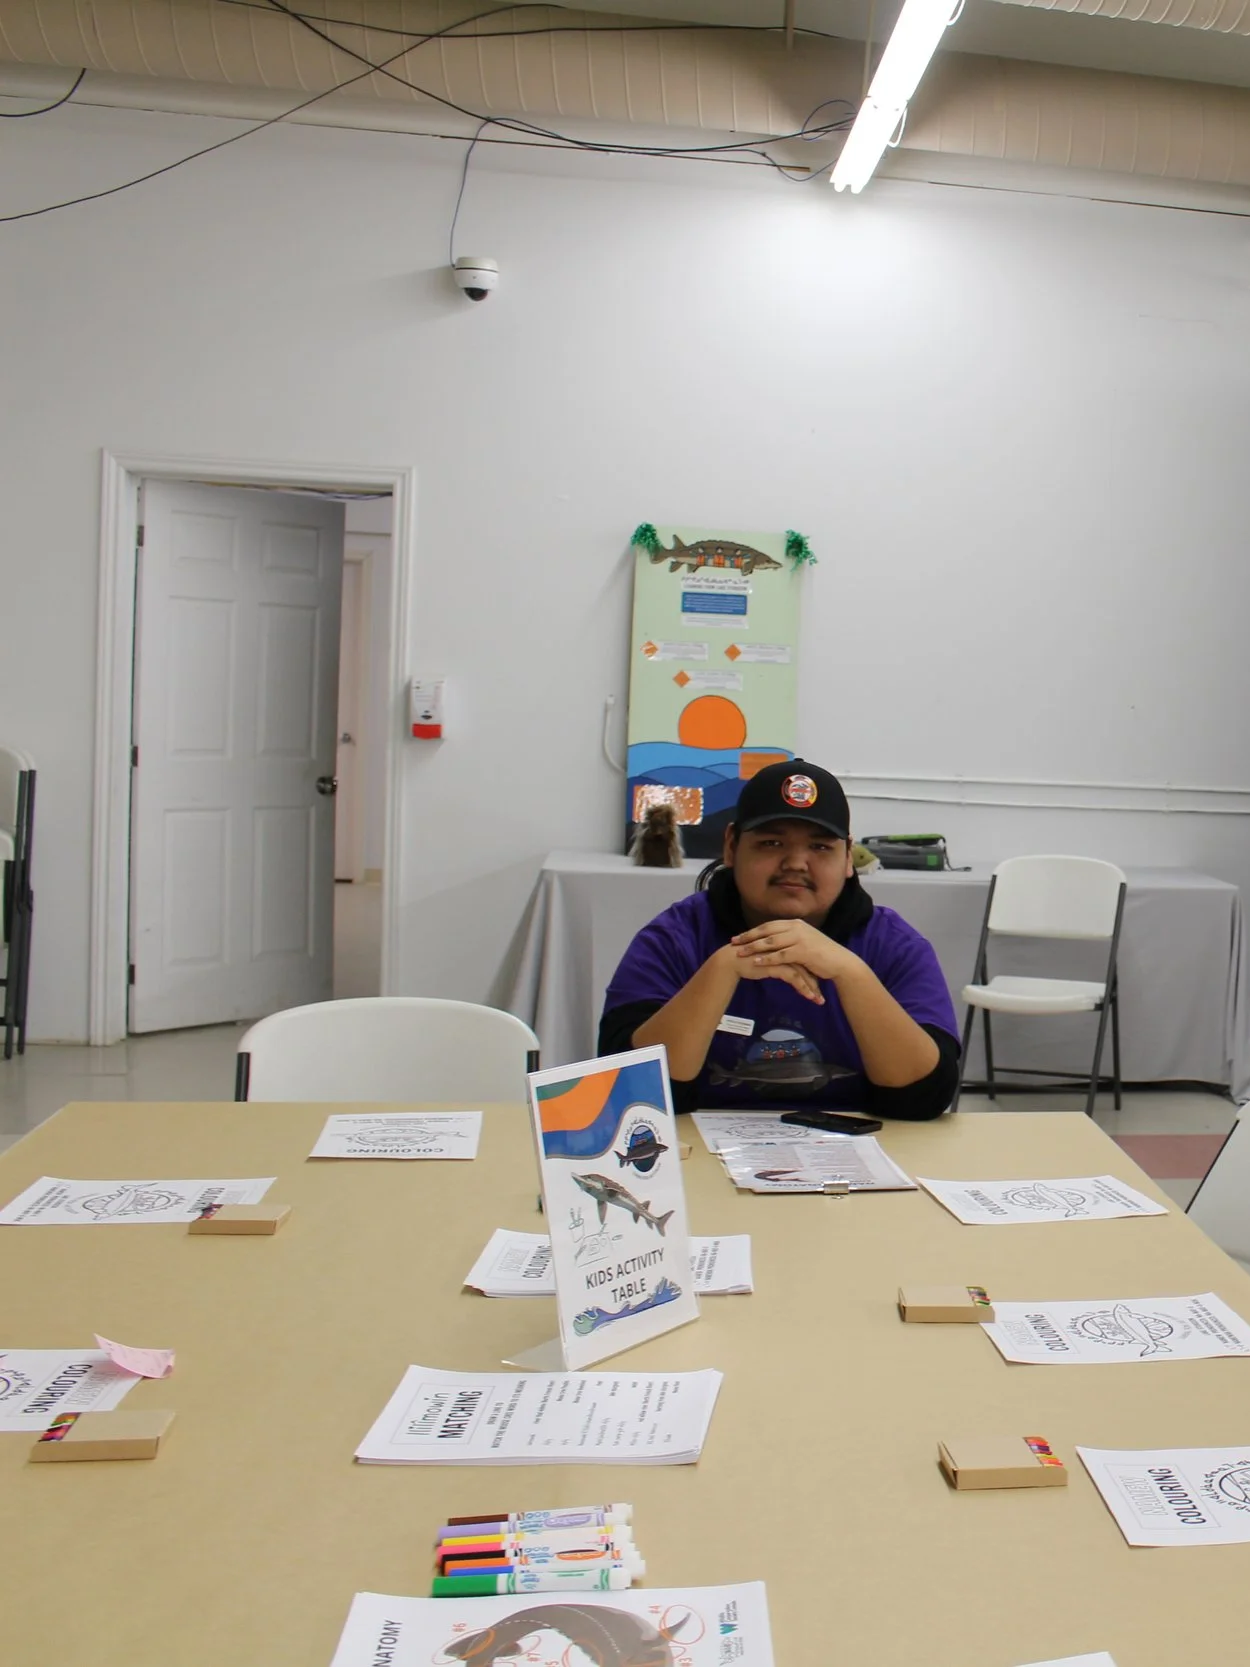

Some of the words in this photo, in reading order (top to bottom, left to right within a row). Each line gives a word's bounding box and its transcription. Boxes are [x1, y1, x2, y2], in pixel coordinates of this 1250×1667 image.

[586, 1266, 613, 1290] KIDS
[616, 1248, 664, 1280] ACTIVITY
[612, 1278, 648, 1304] TABLE
[1025, 1314, 1067, 1350] COLOURING
[23, 1364, 93, 1414] COLOURING
[437, 1391, 483, 1437] MATCHING
[1148, 1468, 1206, 1523] COLOURING
[452, 1622, 467, 1632] #6
[648, 1604, 661, 1614] #4
[528, 1651, 542, 1662] #7
